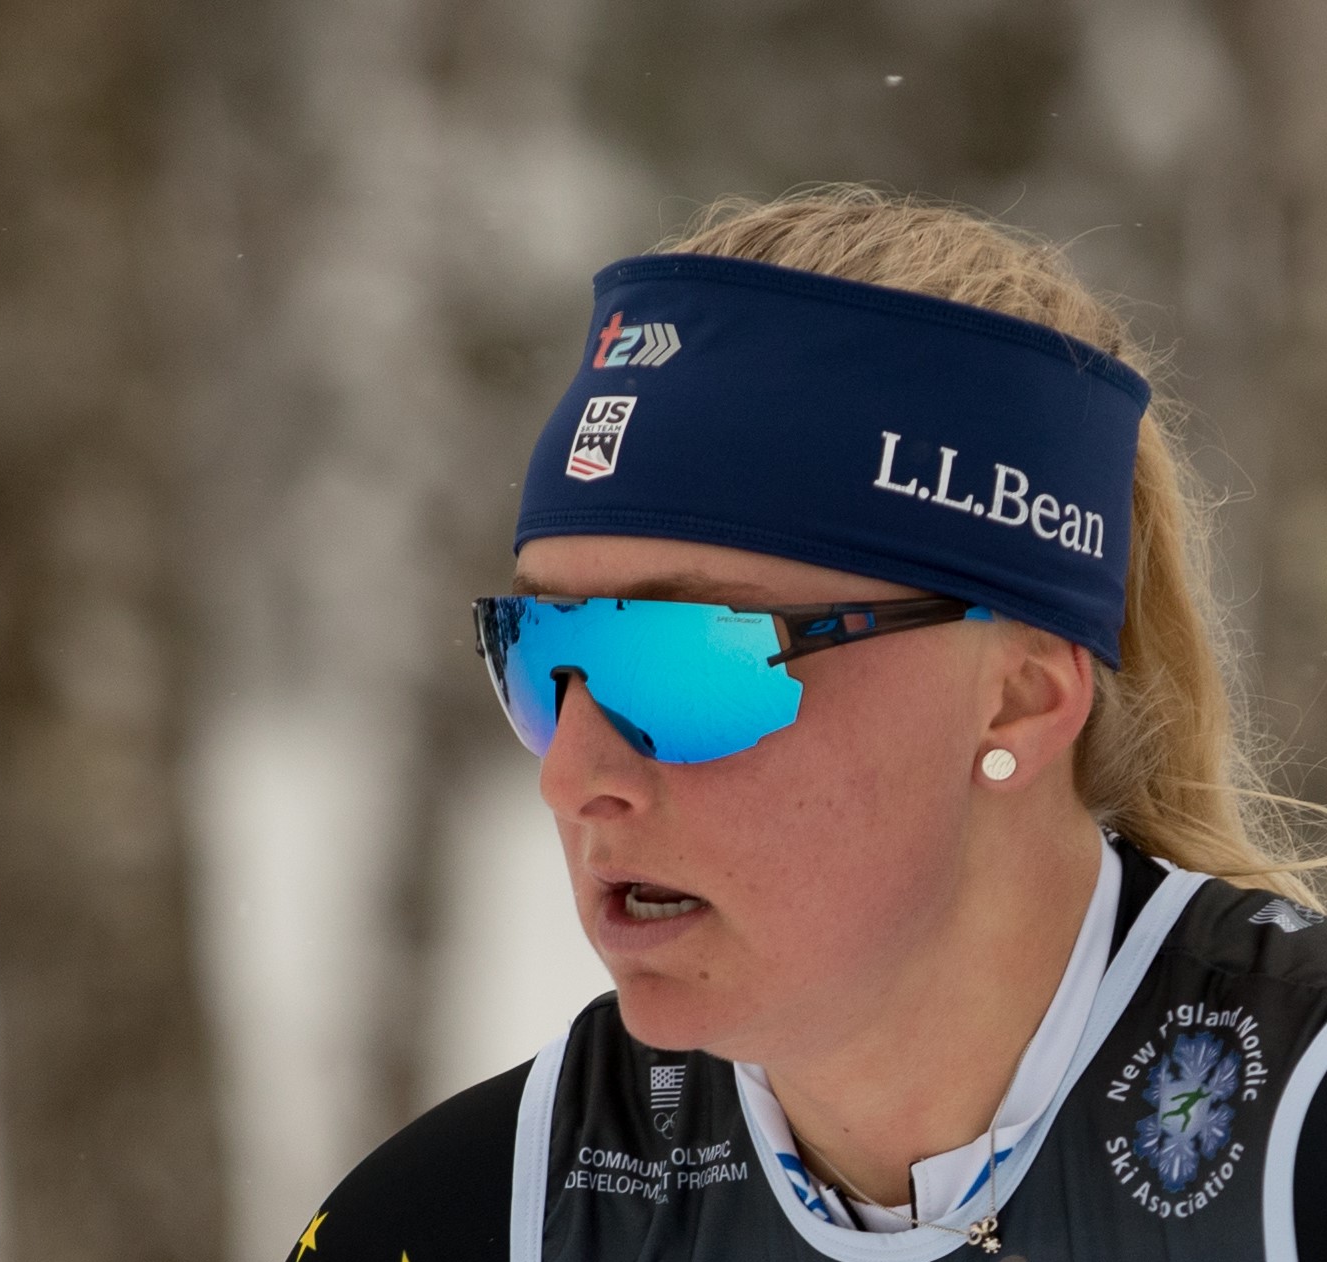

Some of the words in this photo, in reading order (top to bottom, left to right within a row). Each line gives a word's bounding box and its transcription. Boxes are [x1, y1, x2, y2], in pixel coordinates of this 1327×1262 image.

[586, 401, 630, 424] US
[873, 431, 1105, 559] L.L.Bean
[1107, 1041, 1156, 1102] New
[1235, 1014, 1269, 1102] Nordic
[671, 1140, 731, 1166] OLYMPIC
[1105, 1136, 1140, 1185] Ski
[677, 1162, 748, 1190] PROGRAM
